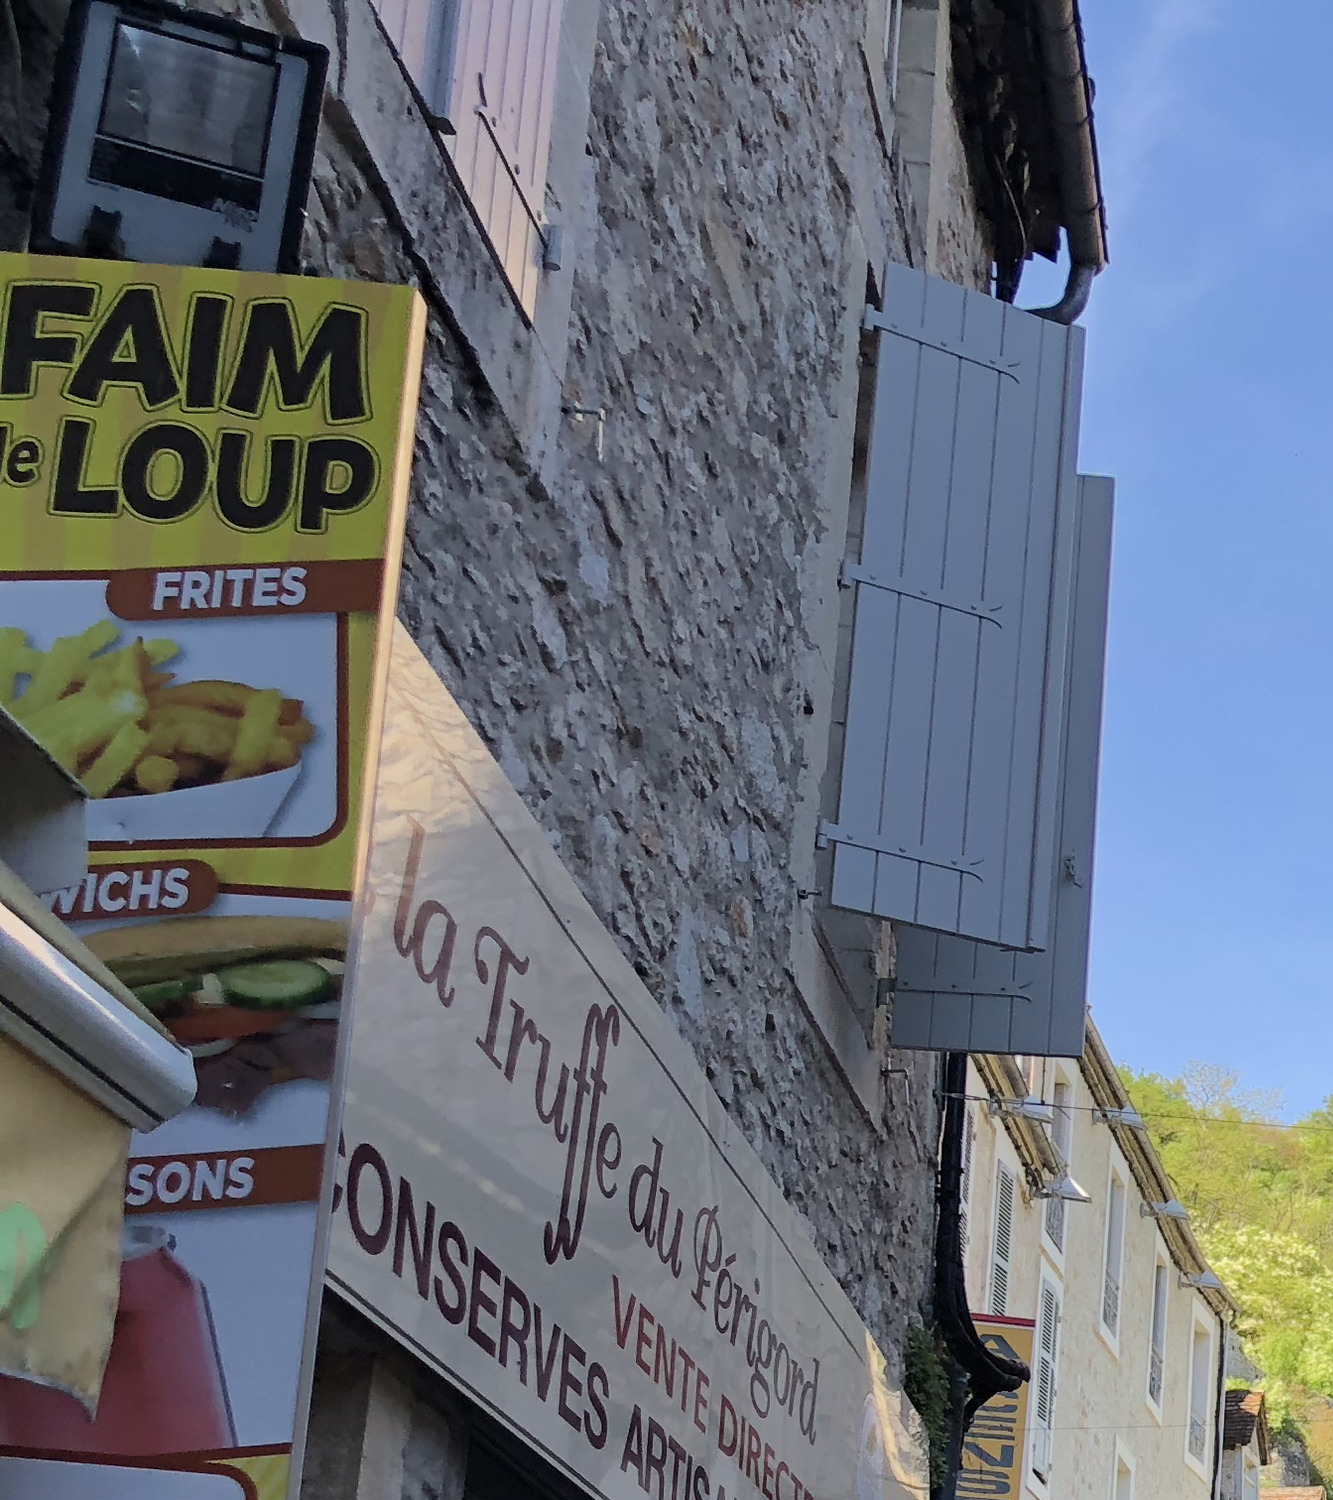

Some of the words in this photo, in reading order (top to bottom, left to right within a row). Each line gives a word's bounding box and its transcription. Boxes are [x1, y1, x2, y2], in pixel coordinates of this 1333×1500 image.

[2, 283, 371, 423] FAIM
[53, 419, 376, 530] LOUP
[153, 567, 307, 610] FRITES
[126, 1156, 255, 1207] SONS
[475, 926, 621, 1265] Truffe
[629, 1136, 684, 1280] du
[691, 1205, 820, 1446] Périgord
[332, 1130, 610, 1451] ONSERVES
[612, 1274, 710, 1434] VENTE
